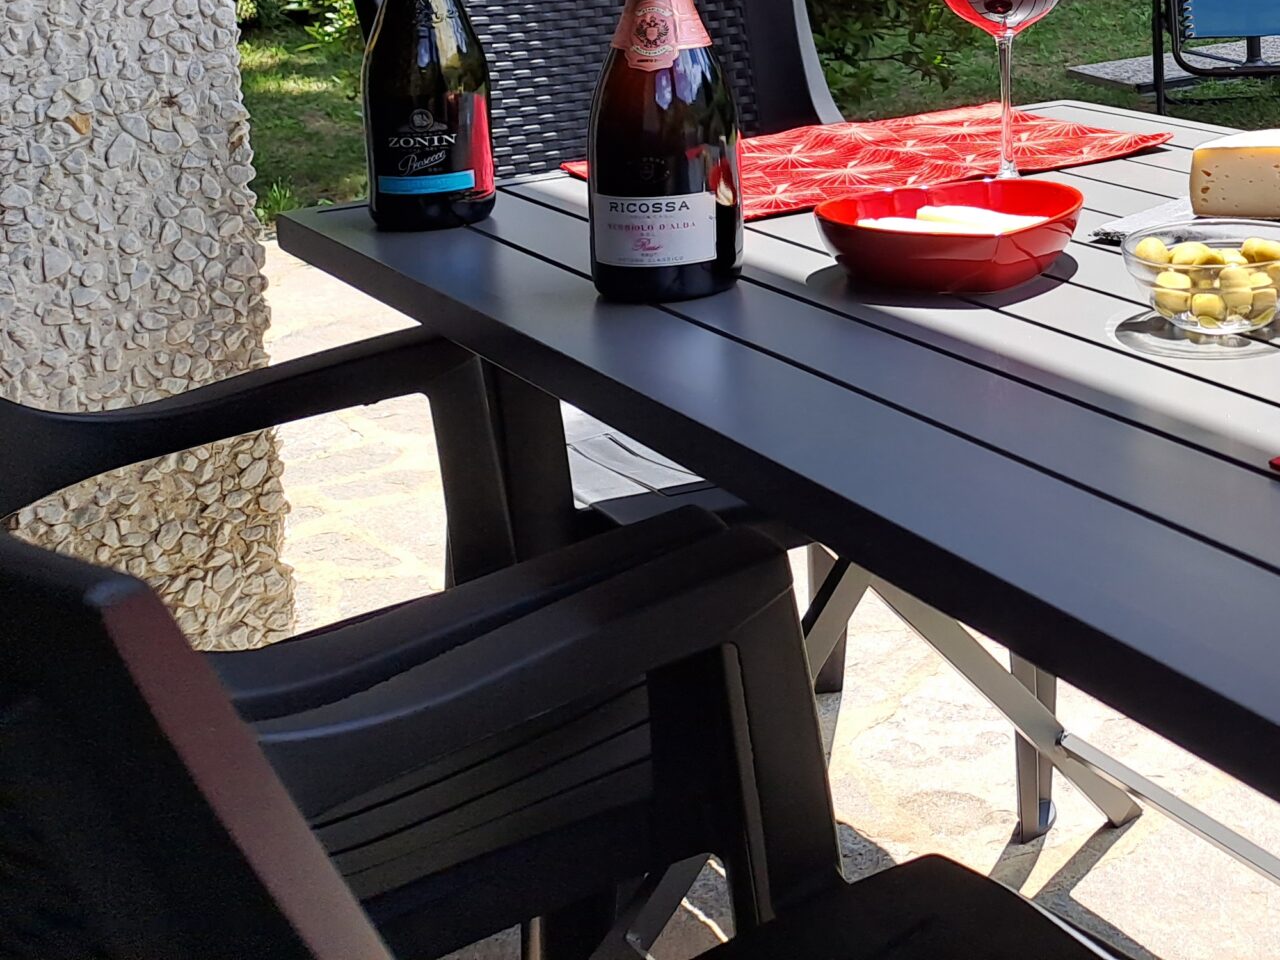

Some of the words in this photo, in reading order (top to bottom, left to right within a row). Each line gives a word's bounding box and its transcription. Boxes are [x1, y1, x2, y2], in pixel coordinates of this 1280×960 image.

[388, 134, 457, 148] ZONIN
[398, 150, 446, 176] Prosecco
[609, 201, 690, 213] RICOSSA
